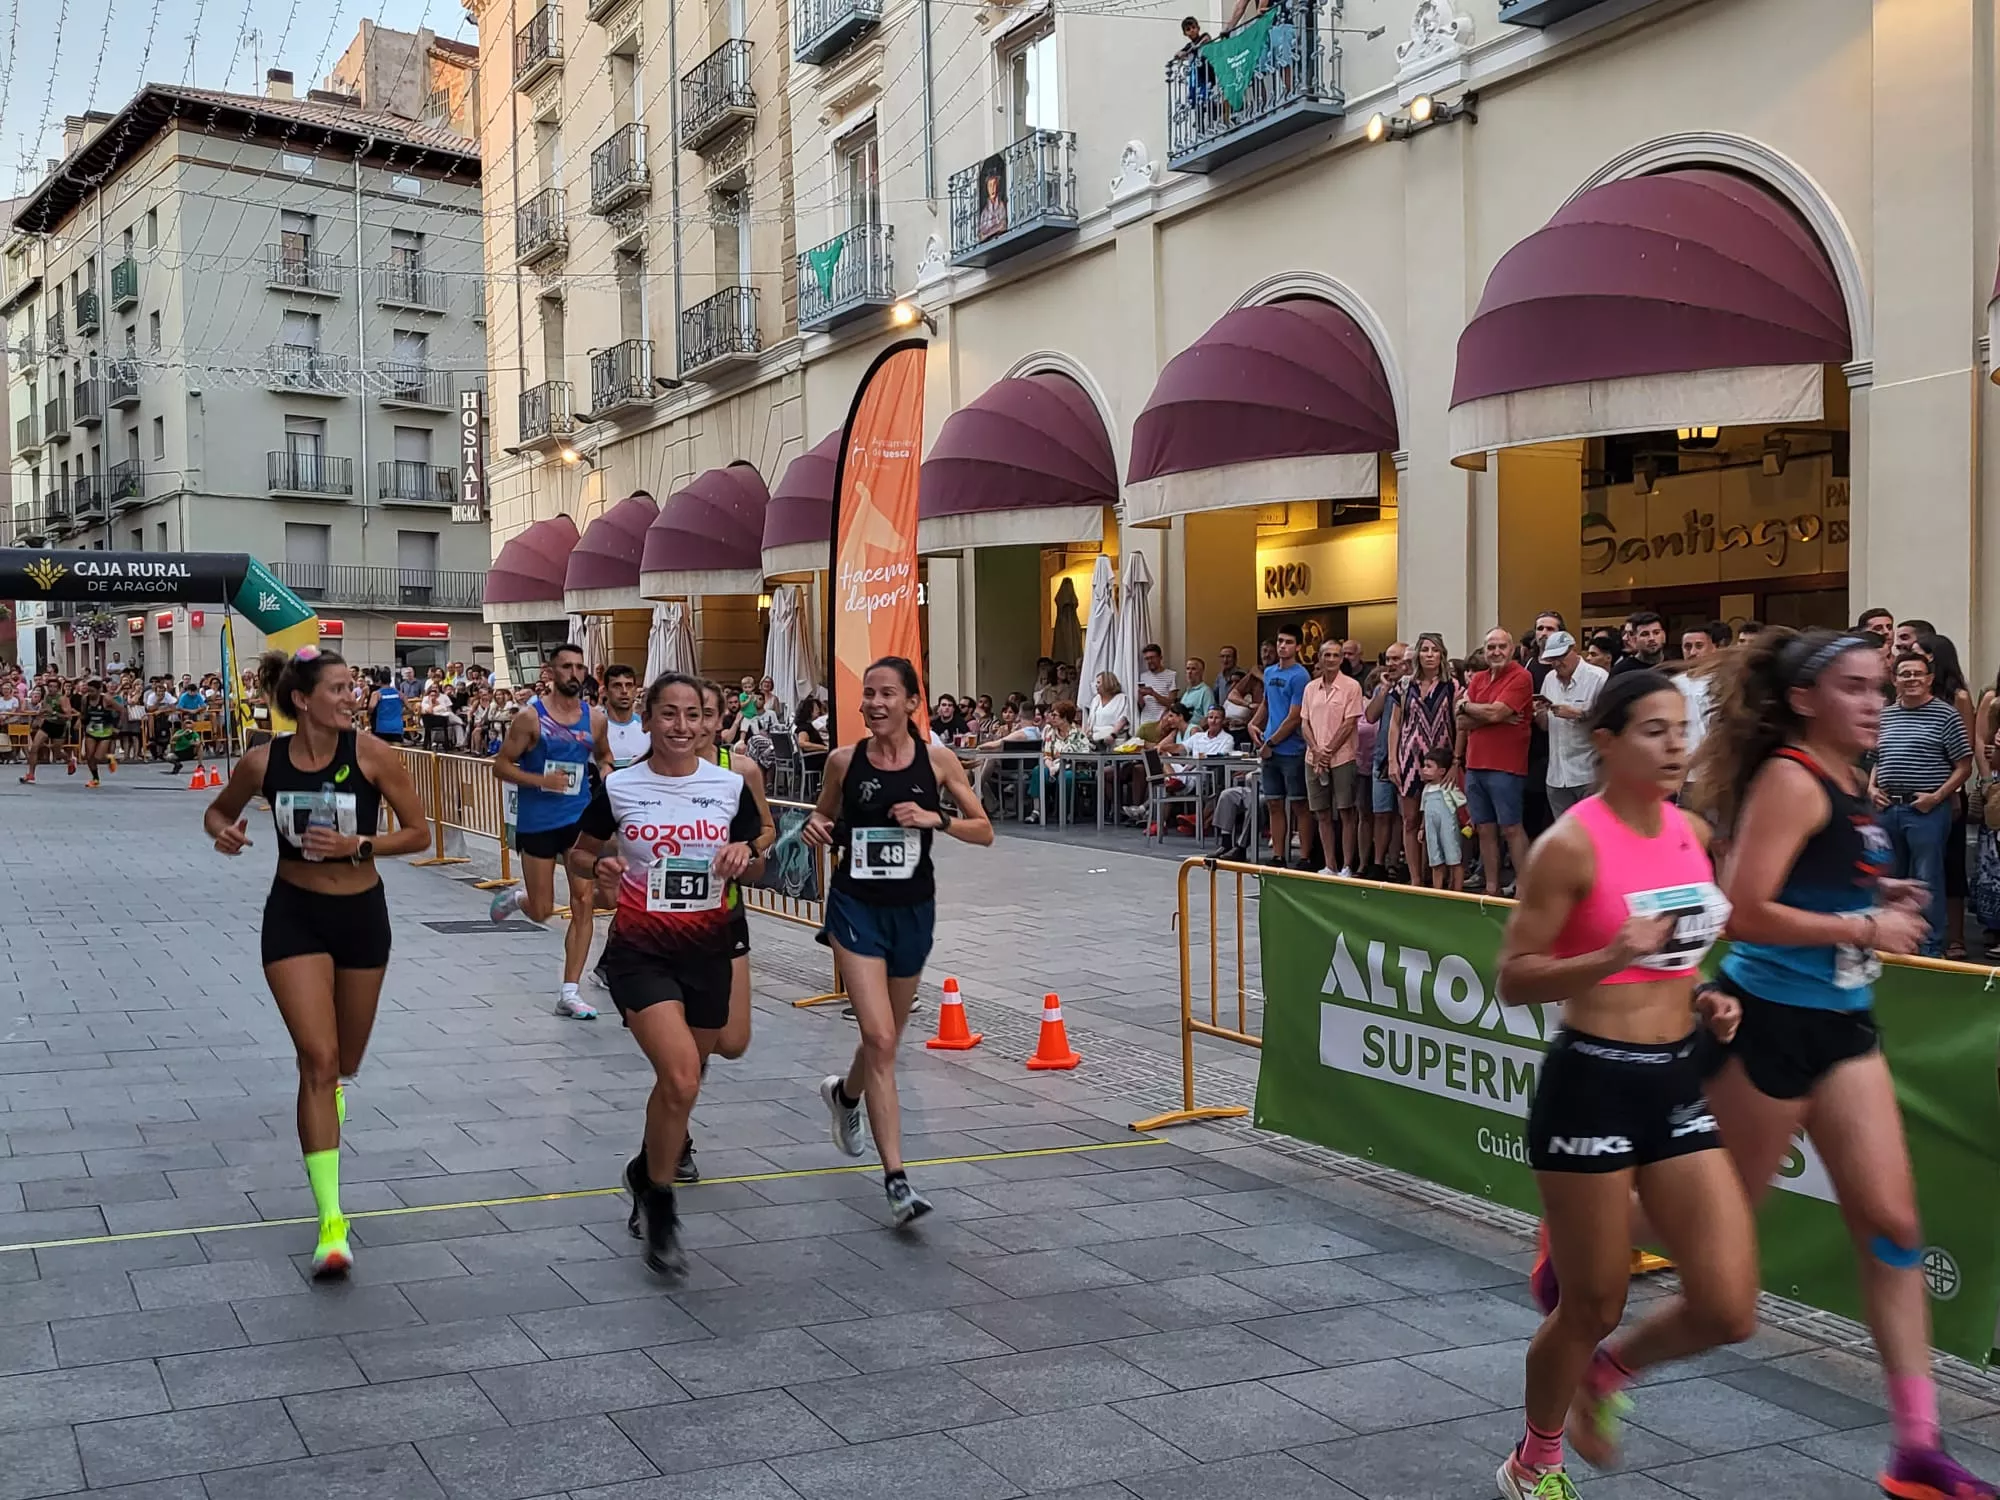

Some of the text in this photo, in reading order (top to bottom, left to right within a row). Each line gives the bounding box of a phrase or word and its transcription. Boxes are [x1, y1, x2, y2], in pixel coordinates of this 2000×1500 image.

[462, 391, 479, 501] HOSTAL
[452, 504, 480, 521] RUGACA
[1580, 509, 1822, 574] Santiago
[74, 561, 191, 577] CAJA RURAL
[88, 579, 178, 592] DE ARAGÓN
[880, 845, 904, 864] 48
[680, 876, 705, 896] 51
